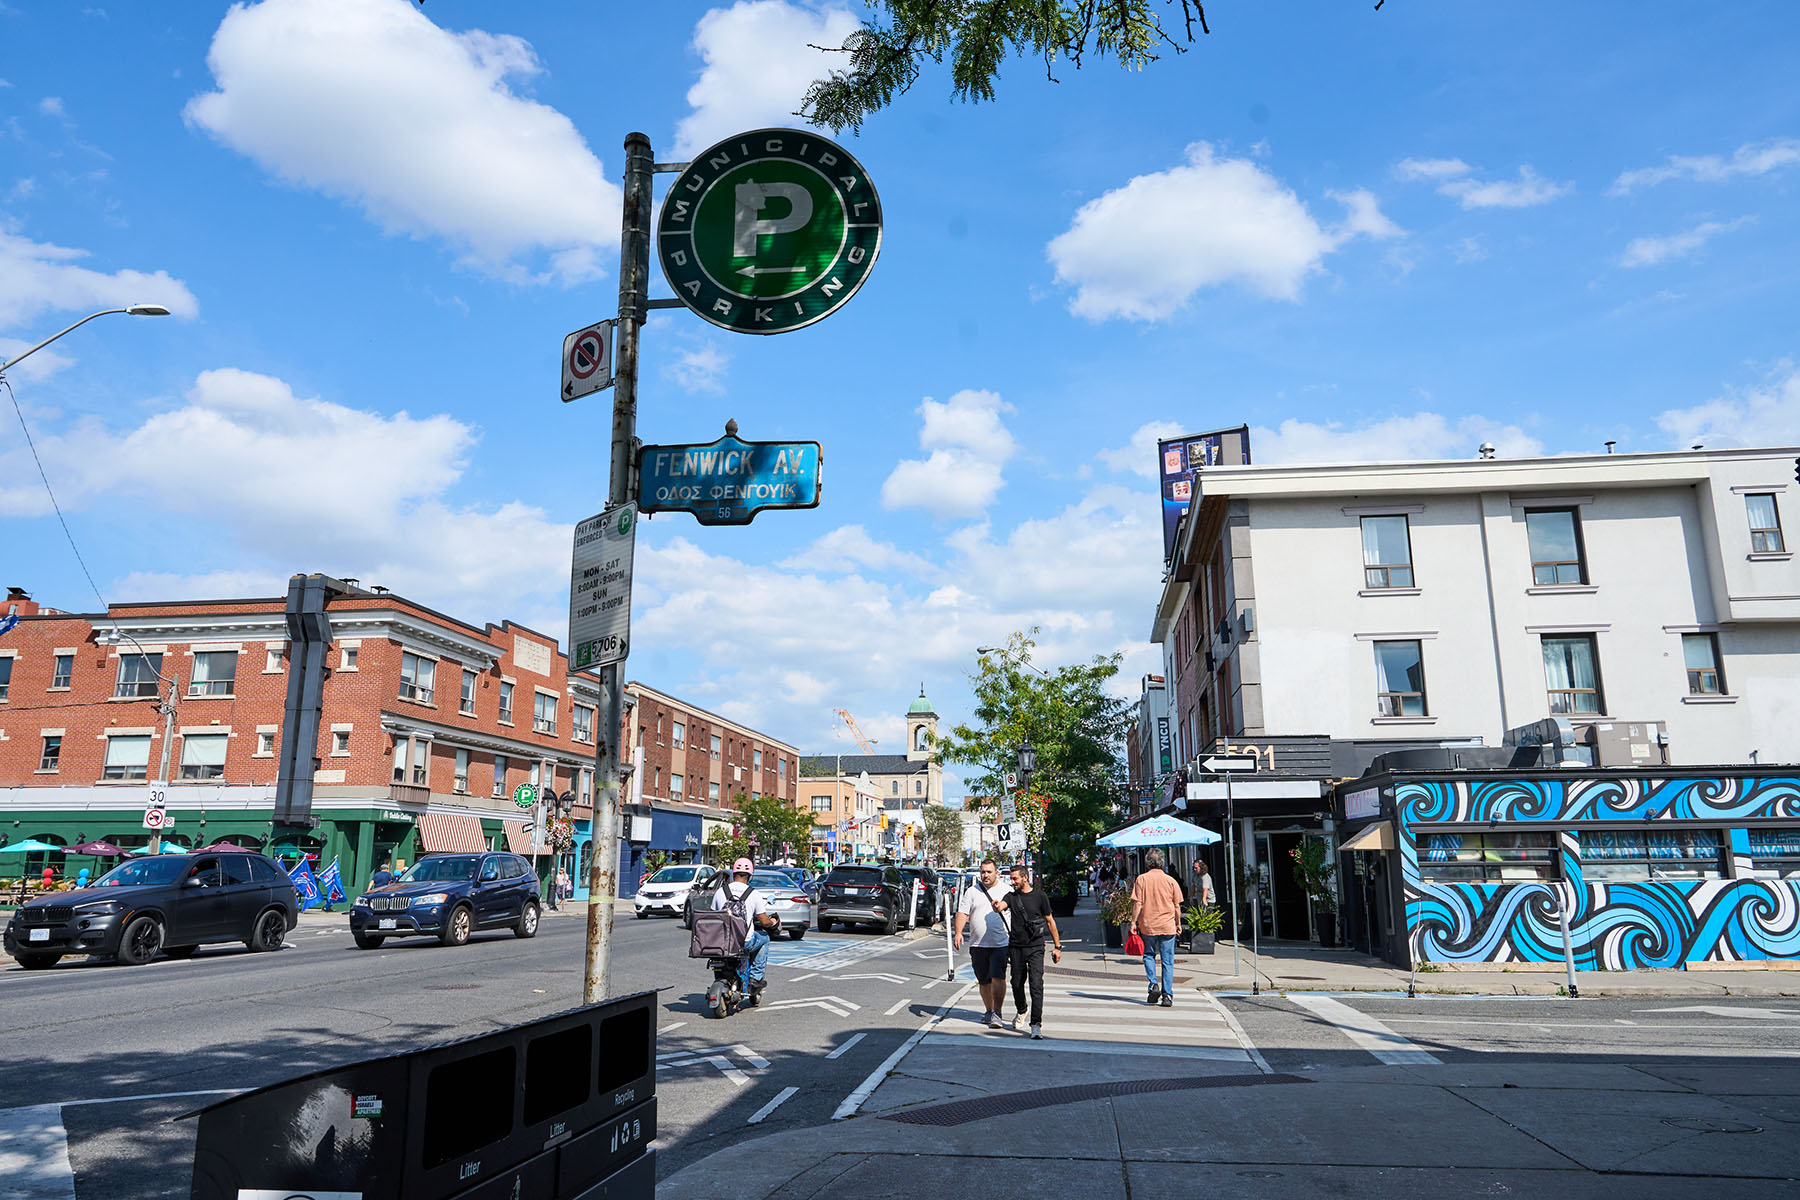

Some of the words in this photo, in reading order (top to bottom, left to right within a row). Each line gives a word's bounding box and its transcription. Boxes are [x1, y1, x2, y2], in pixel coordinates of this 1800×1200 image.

[671, 139, 869, 222] MUNICIPAL
[733, 182, 814, 257] P
[670, 245, 866, 323] PARKING
[655, 450, 754, 477] FENWICK
[773, 449, 804, 475] AV.
[656, 486, 702, 500] ΟΔΟΣ
[710, 483, 797, 499] ΦΕΝΓΟΥΙΚ
[718, 507, 731, 519] 56
[577, 525, 588, 536] PAY
[577, 530, 603, 548] ENFORCED
[584, 564, 599, 579] MON
[606, 558, 620, 571] SAT
[603, 569, 625, 585] 9:00PM
[593, 588, 607, 601] SUN
[577, 604, 598, 619] 1:00PM
[602, 596, 624, 611] 9:00PM
[592, 636, 617, 656] 5706
[1159, 721, 1170, 751] YNCU
[150, 790, 164, 802] 30
[521, 789, 531, 800] P
[1140, 827, 1177, 835] Coors
[614, 1088, 635, 1106] Recycling
[549, 1121, 566, 1138] Litter
[459, 1160, 481, 1179] Litter
